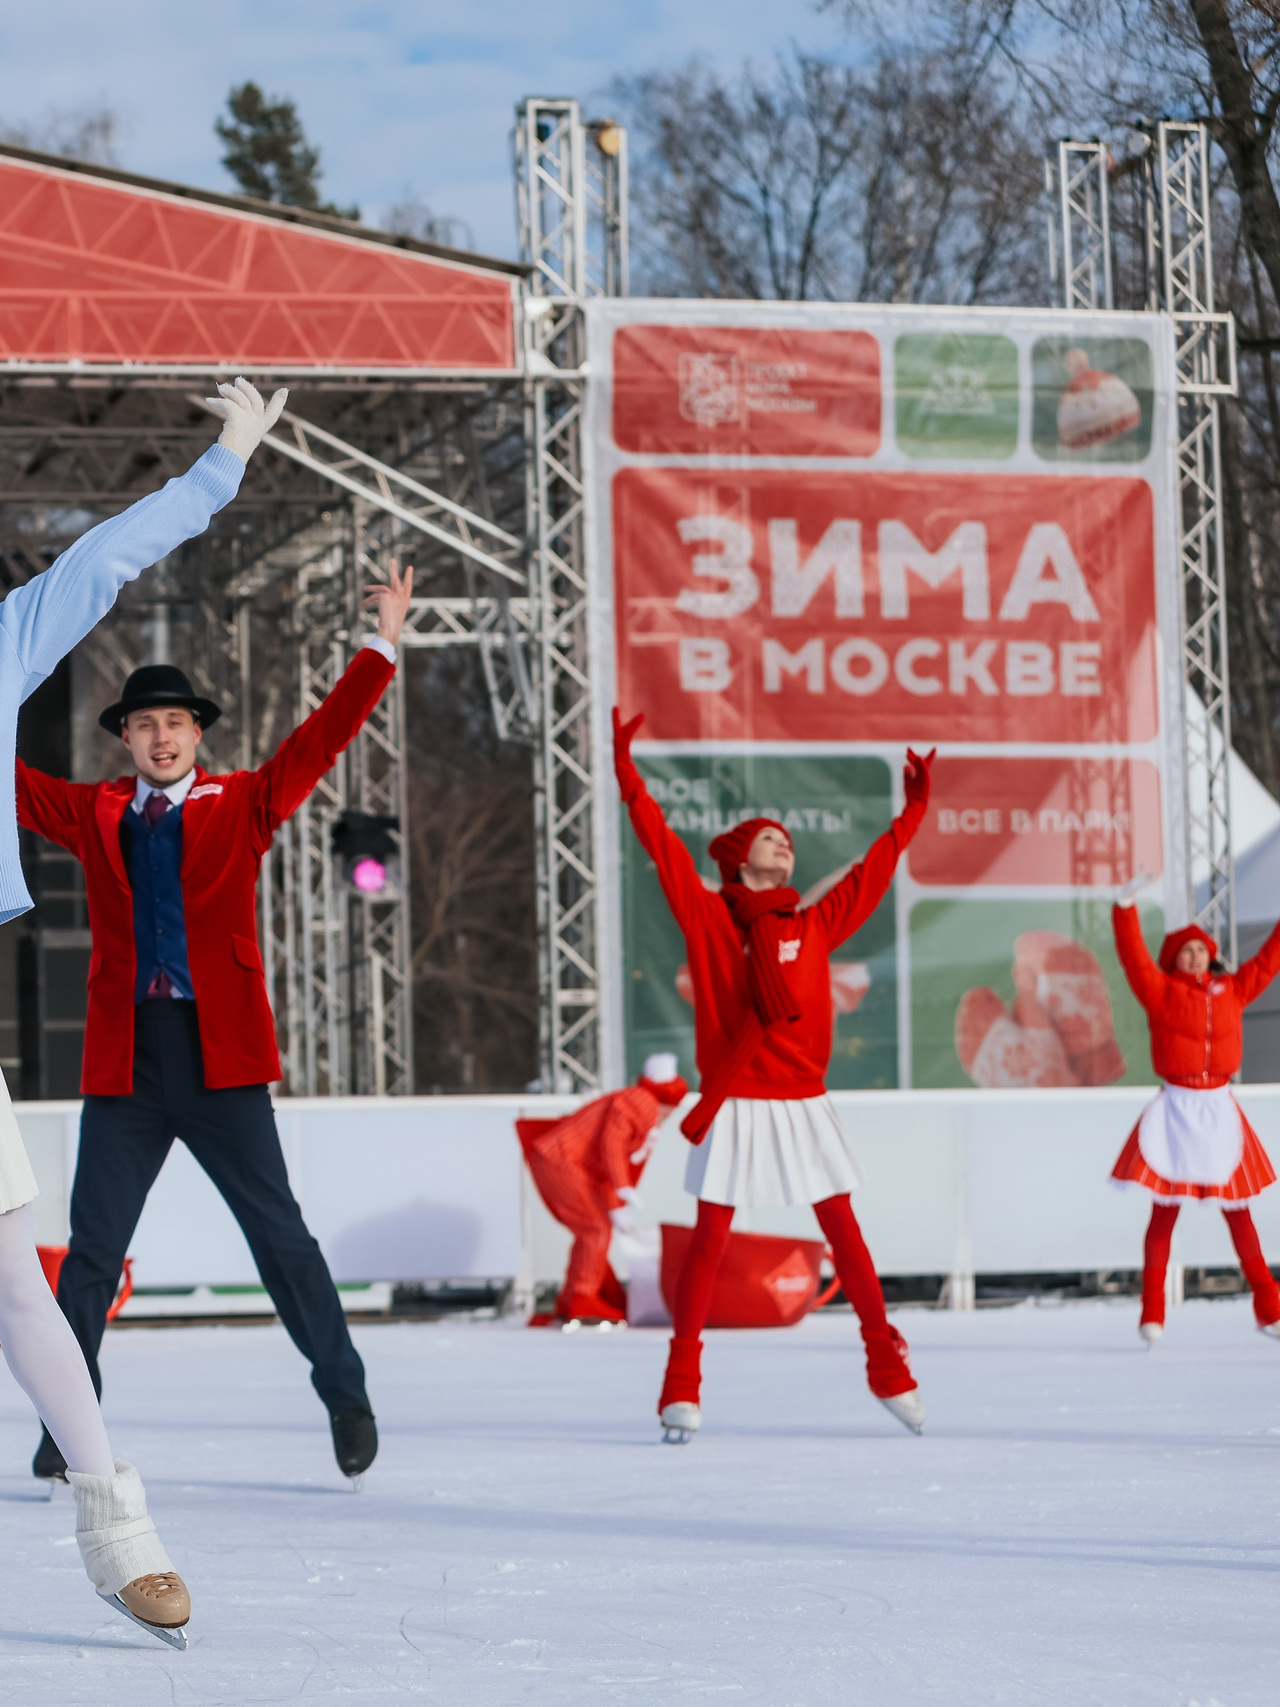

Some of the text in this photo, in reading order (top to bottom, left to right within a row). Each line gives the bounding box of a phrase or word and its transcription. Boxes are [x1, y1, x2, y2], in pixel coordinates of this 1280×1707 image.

[675, 513, 1100, 623] ЗИМА
[677, 636, 1103, 697] В МОСКВЕ
[937, 808, 1002, 834] ВСЕ
[1010, 808, 1032, 834] В
